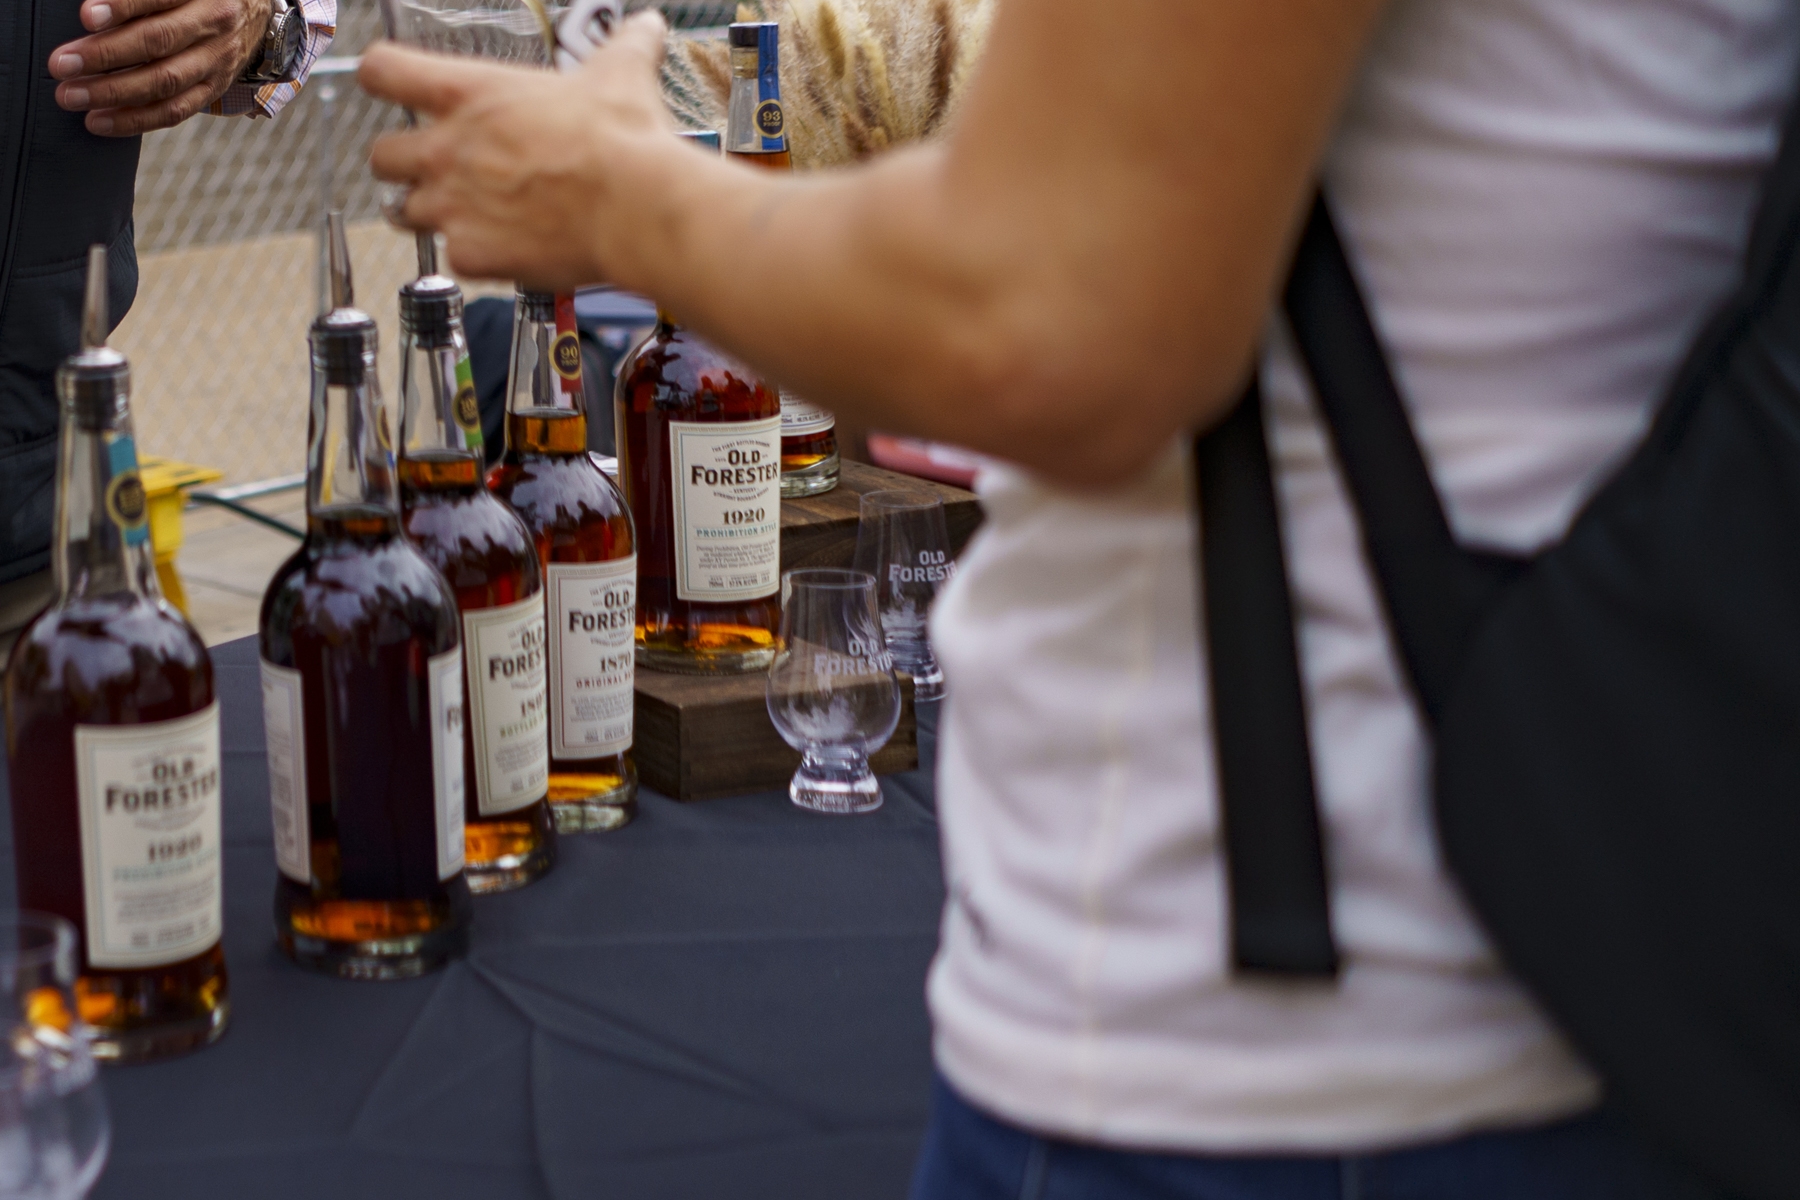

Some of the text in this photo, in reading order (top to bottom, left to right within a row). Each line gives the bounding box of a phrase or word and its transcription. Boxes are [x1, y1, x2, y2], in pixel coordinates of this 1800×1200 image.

[762, 111, 781, 121] 93
[560, 346, 578, 360] 90
[727, 448, 761, 466] OLD
[690, 461, 779, 487] FORESTER
[722, 507, 766, 526] 1920
[696, 522, 777, 538] PROHIBITION STYLE
[918, 549, 946, 566] OLD
[603, 589, 630, 609] OLD
[521, 625, 543, 650] OLD
[847, 638, 880, 657] OLD
[600, 650, 631, 673] 1870
[575, 674, 622, 689] ORIGINAL
[151, 759, 195, 783] OLD
